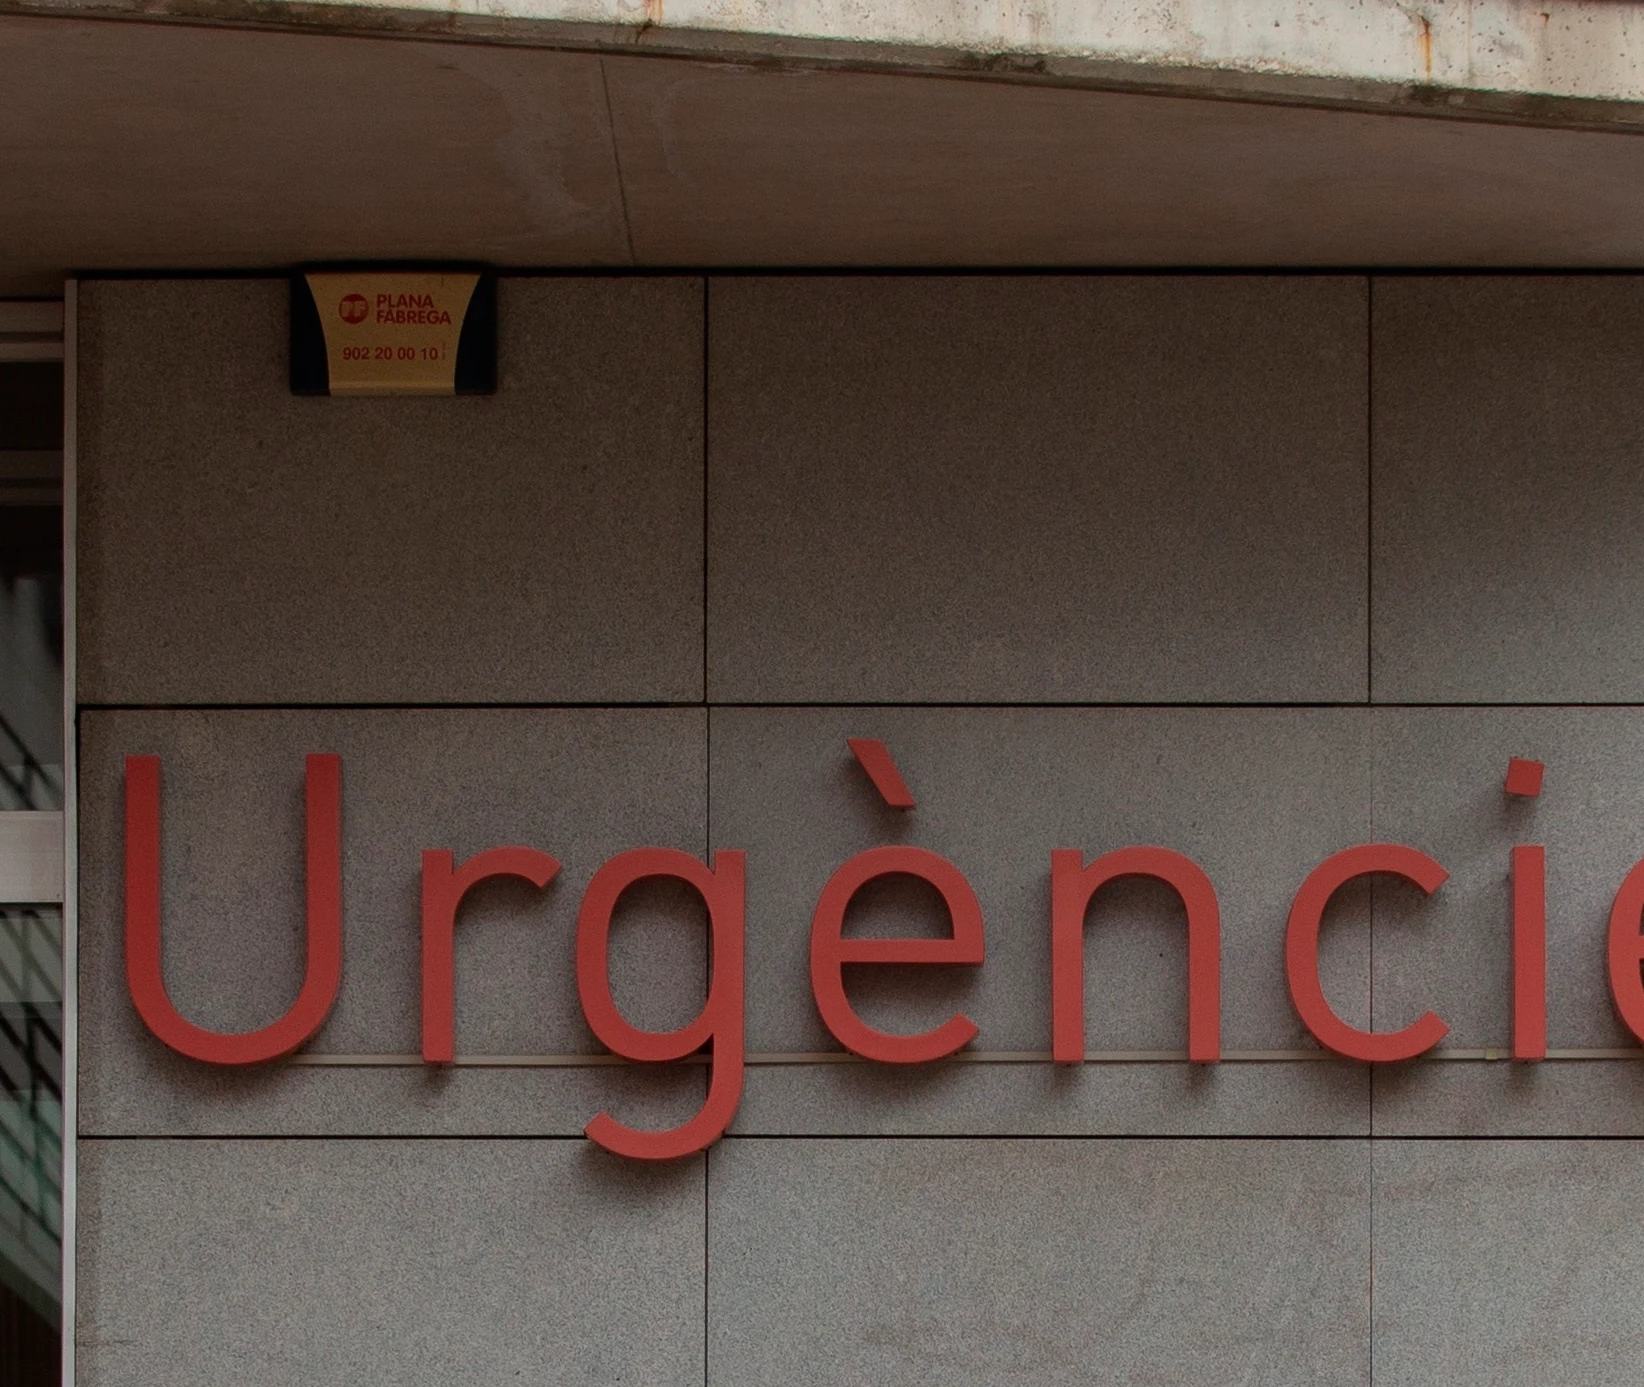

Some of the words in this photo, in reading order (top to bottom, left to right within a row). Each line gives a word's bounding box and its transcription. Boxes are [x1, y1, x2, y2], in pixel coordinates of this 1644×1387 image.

[376, 293, 434, 309] PLANA
[342, 346, 370, 361] 902
[374, 346, 393, 361] 20
[397, 346, 416, 361] 00
[421, 346, 439, 361] 10
